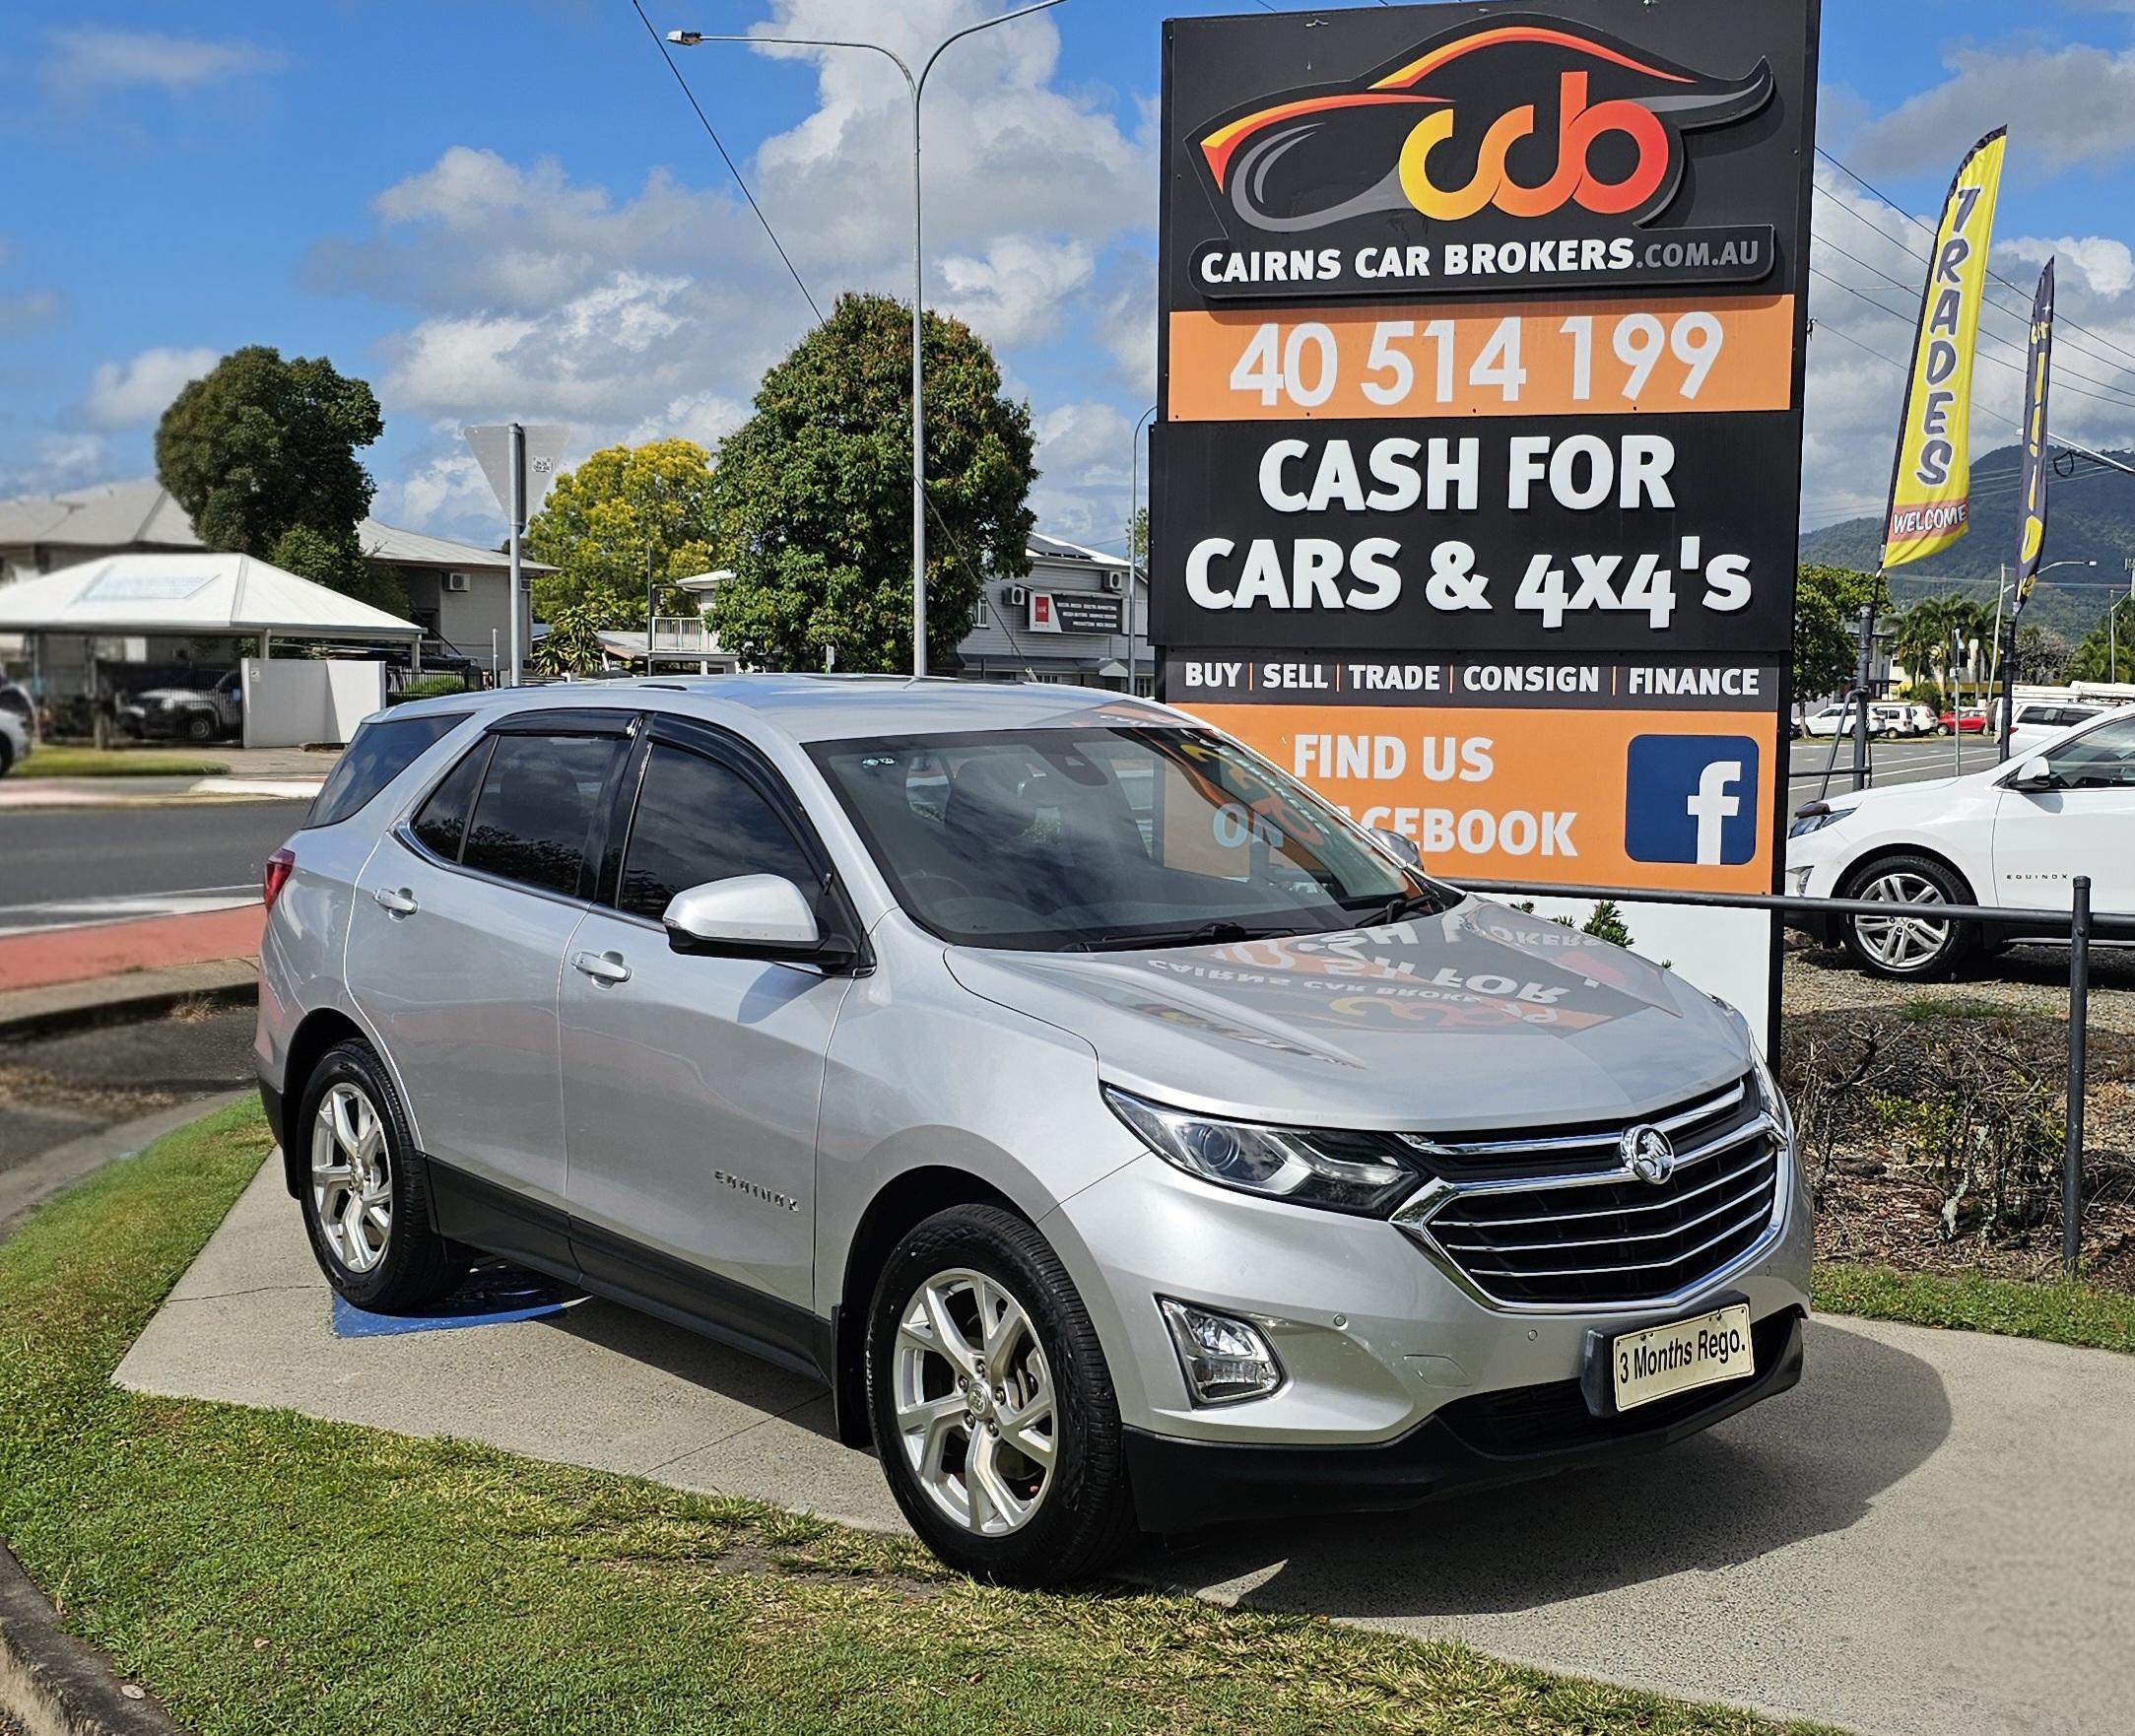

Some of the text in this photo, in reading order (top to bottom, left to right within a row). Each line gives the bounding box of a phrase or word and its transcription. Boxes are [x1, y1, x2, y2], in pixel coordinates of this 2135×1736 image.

[1201, 248, 1342, 284] CAIRNS
[1355, 245, 1431, 279] CAR
[1230, 311, 1724, 407] 40 514 199
[1915, 186, 1981, 487] TRADES
[1258, 434, 1676, 512] CASH FOR
[1893, 503, 1968, 535] WELCOME
[1185, 537, 1402, 611] CARS
[1425, 540, 1493, 611] &
[1184, 661, 1760, 697] BUY SELL TRADE CONSIGN FINANCE
[1293, 733, 1495, 783] FIND US
[1619, 1328, 1746, 1384] 3 Months Rego.
